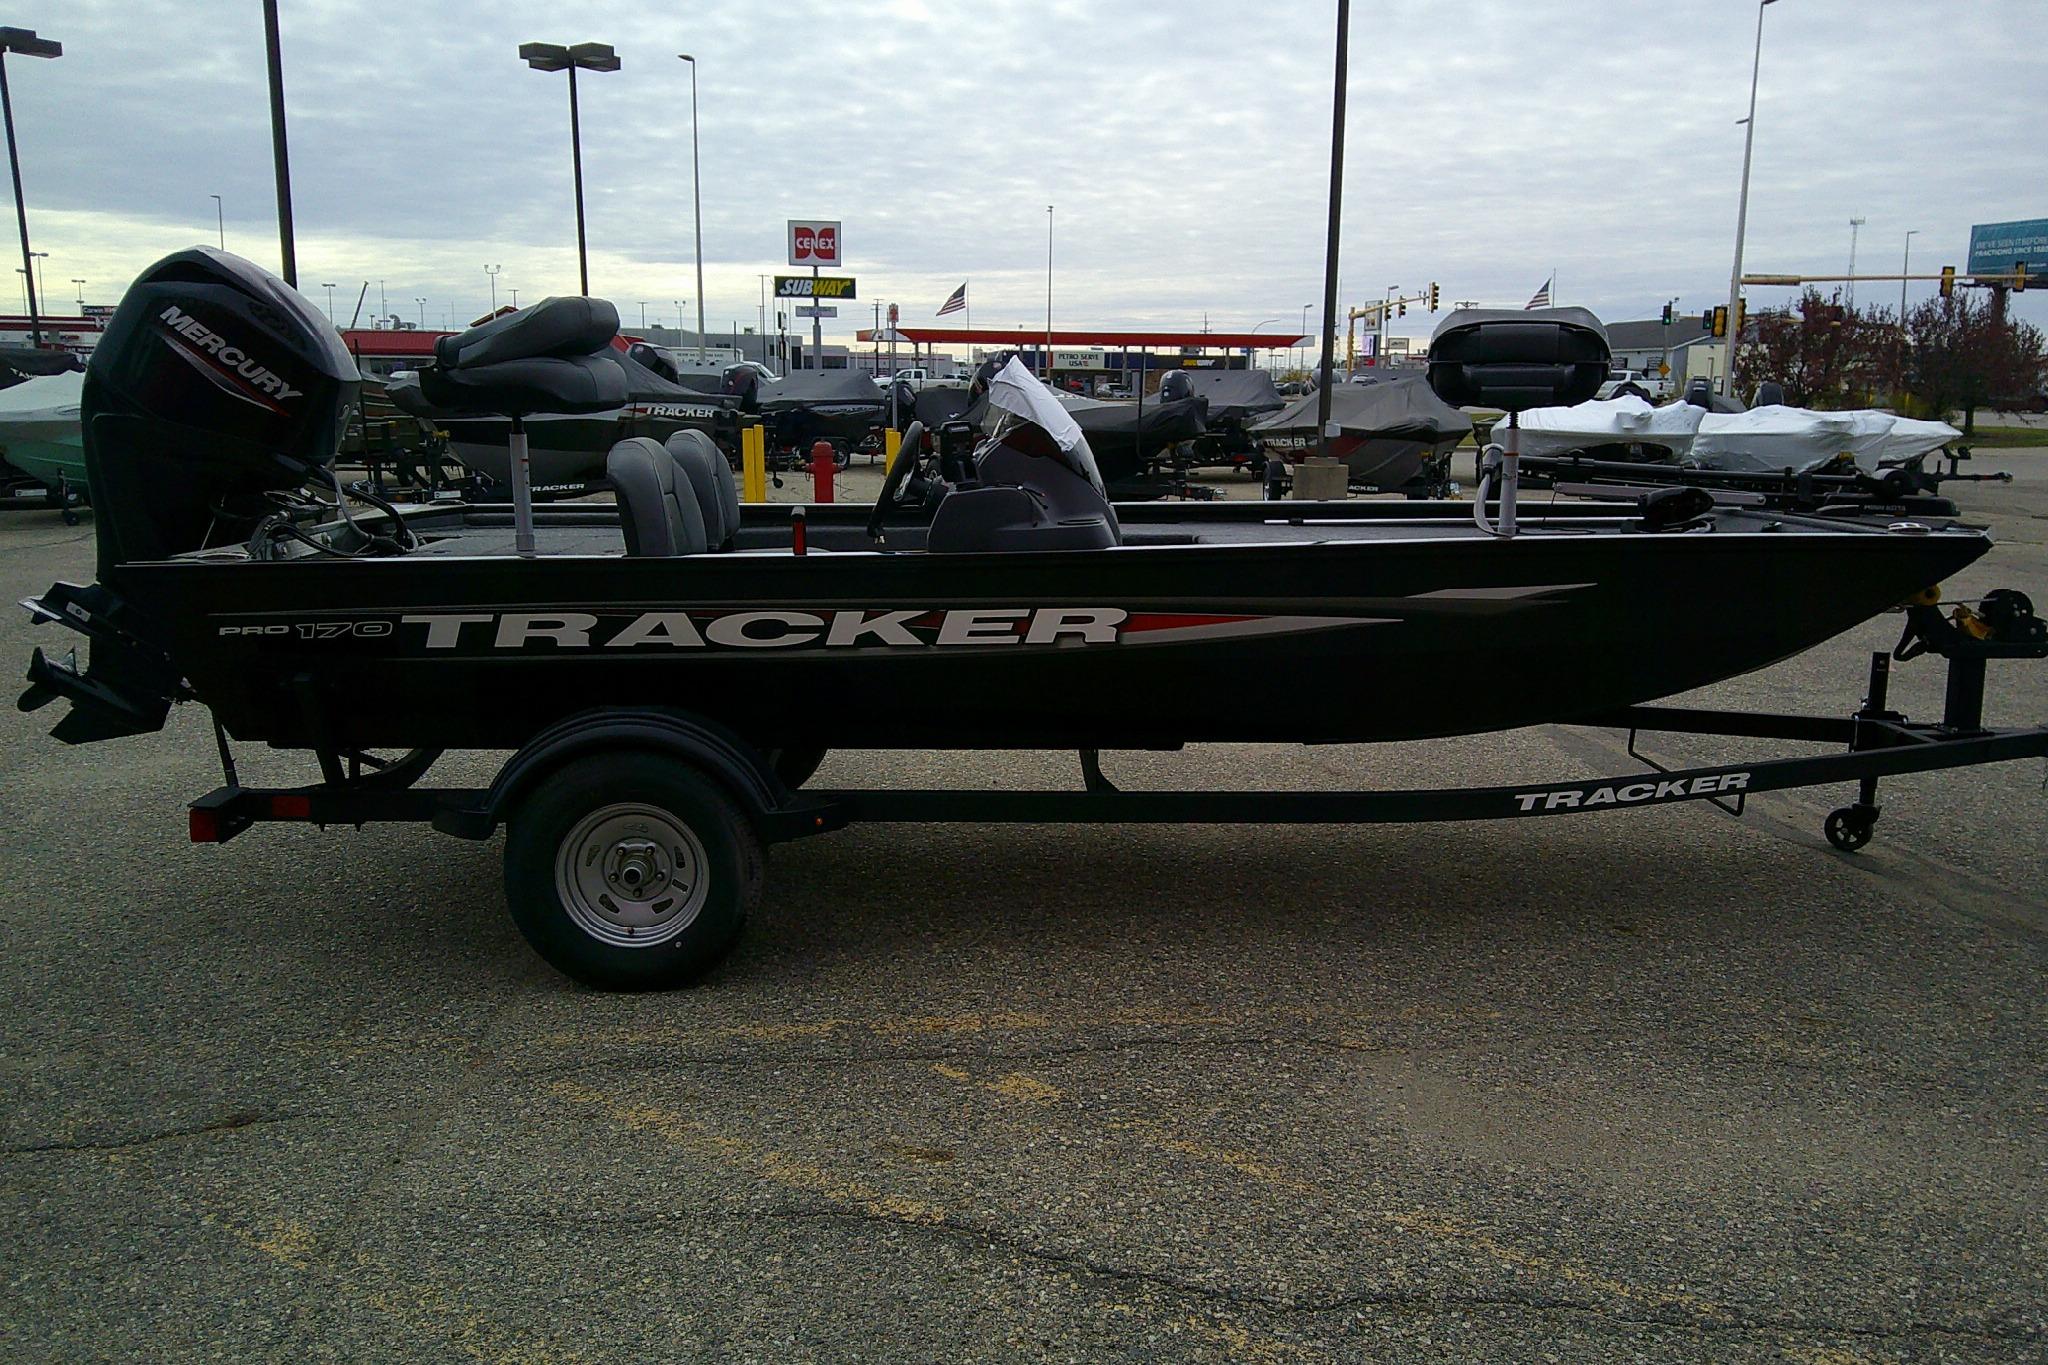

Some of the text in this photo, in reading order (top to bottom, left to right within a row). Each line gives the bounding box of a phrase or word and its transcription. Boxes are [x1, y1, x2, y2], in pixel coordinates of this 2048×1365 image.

[796, 237, 834, 249] CENEX
[780, 279, 850, 295] SUBWAY
[160, 305, 303, 400] MERCURY
[1058, 353, 1099, 361] PETRO SERVE
[646, 406, 714, 418] TRACKER
[1265, 437, 1306, 447] TRACKER
[218, 607, 1128, 649] PRO 170 TRACKER
[1515, 772, 1751, 811] TRACKER
